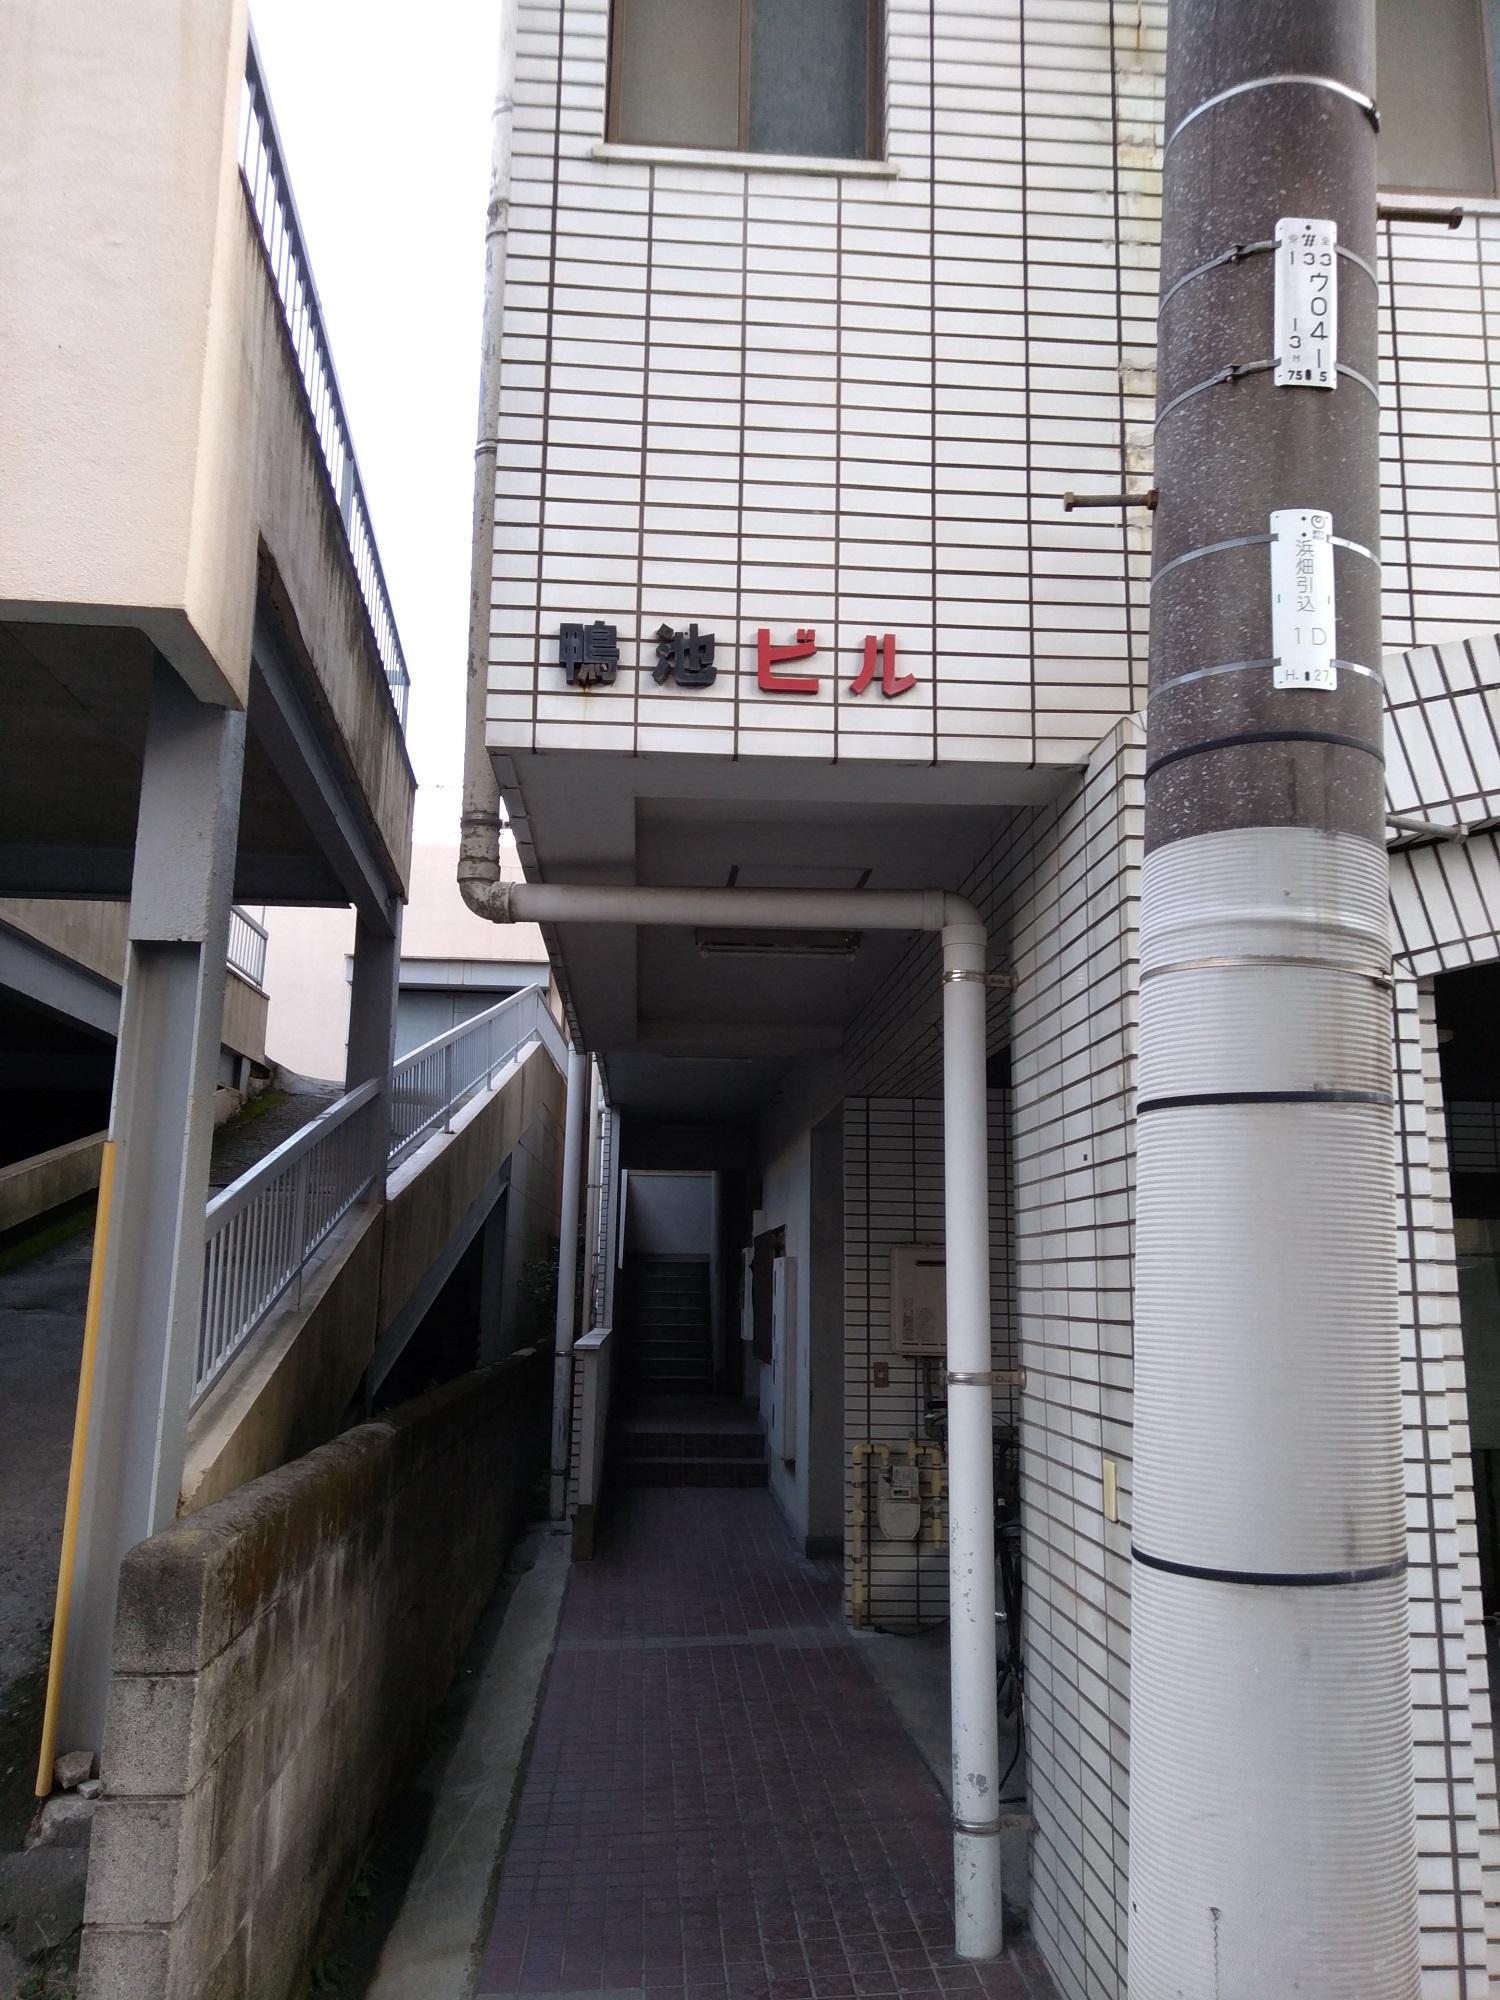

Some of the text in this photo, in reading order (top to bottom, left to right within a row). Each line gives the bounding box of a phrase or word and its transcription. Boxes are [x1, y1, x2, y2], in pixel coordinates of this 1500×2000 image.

[1290, 251, 1332, 266] 133
[1287, 370, 1303, 381] 75
[559, 620, 917, 698] 鴨池ビル
